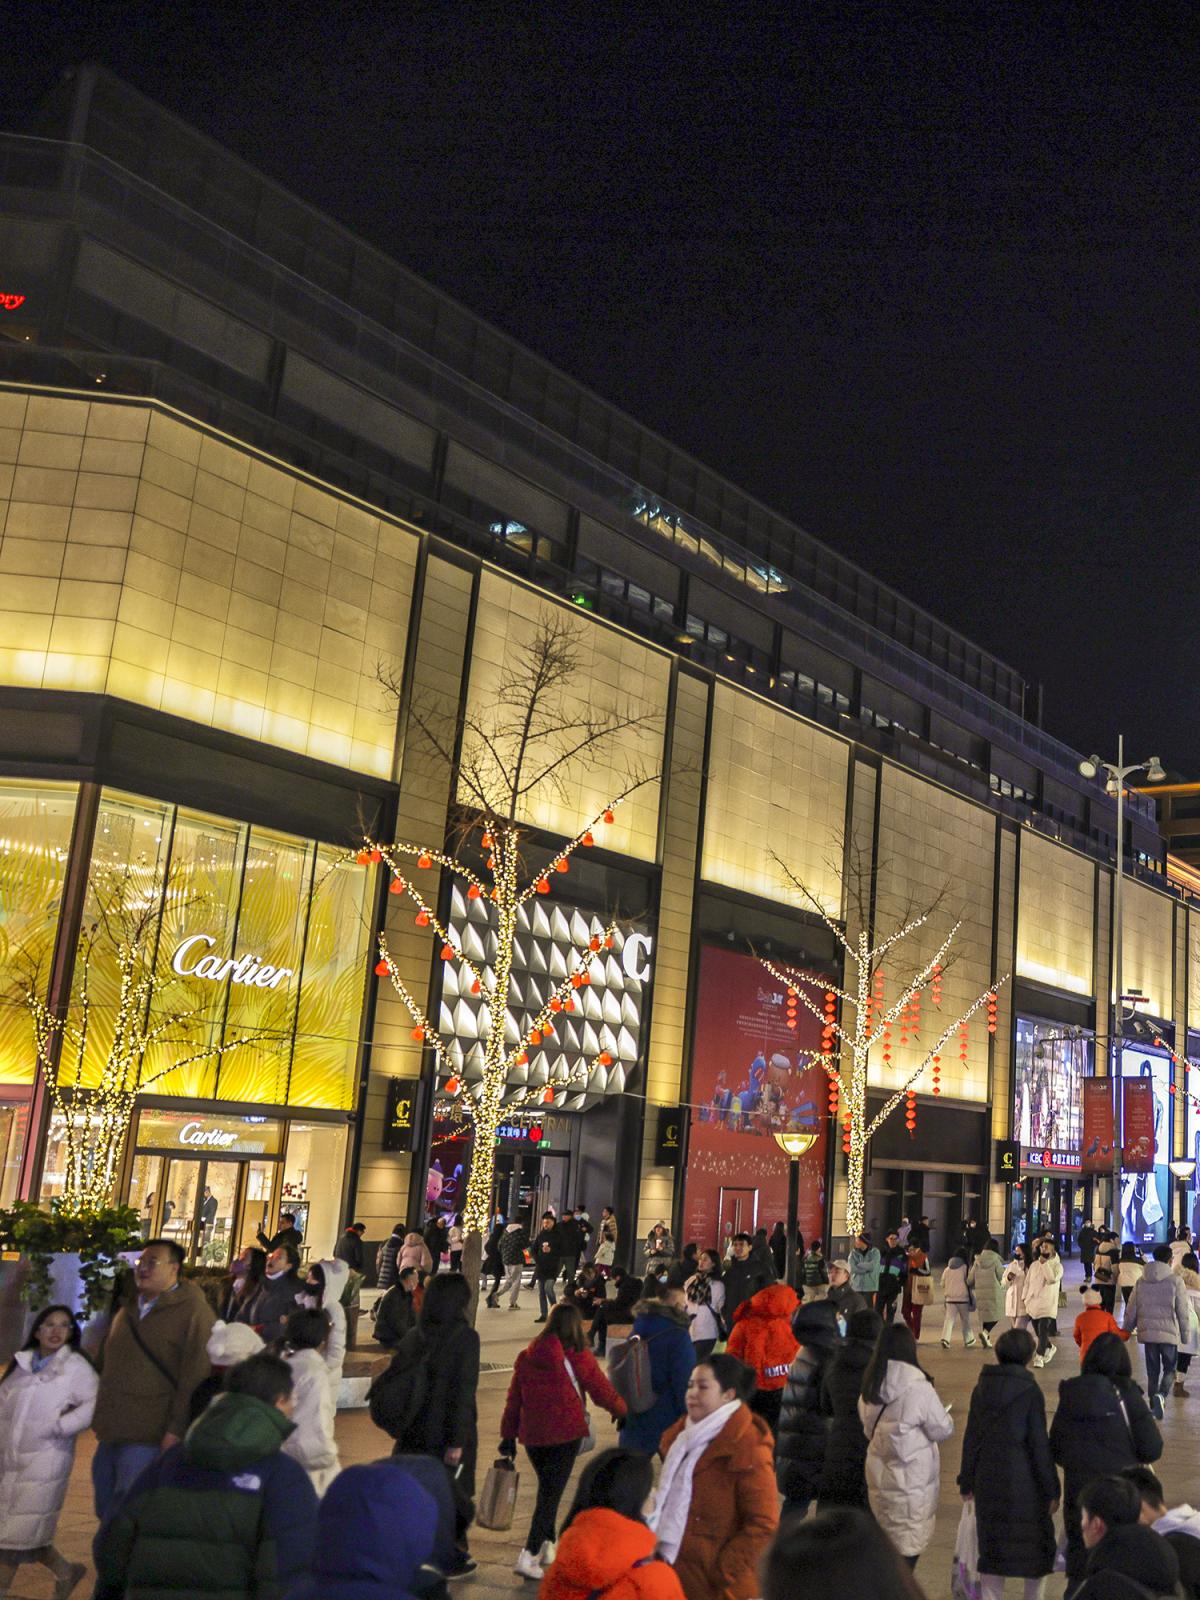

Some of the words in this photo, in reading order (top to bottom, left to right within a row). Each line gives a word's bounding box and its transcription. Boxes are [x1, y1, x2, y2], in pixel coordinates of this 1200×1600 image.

[173, 934, 292, 989] Cartier
[623, 933, 652, 982] C
[396, 1100, 410, 1119] C
[179, 1122, 238, 1146] Cartier
[511, 1113, 572, 1133] CENTRAL
